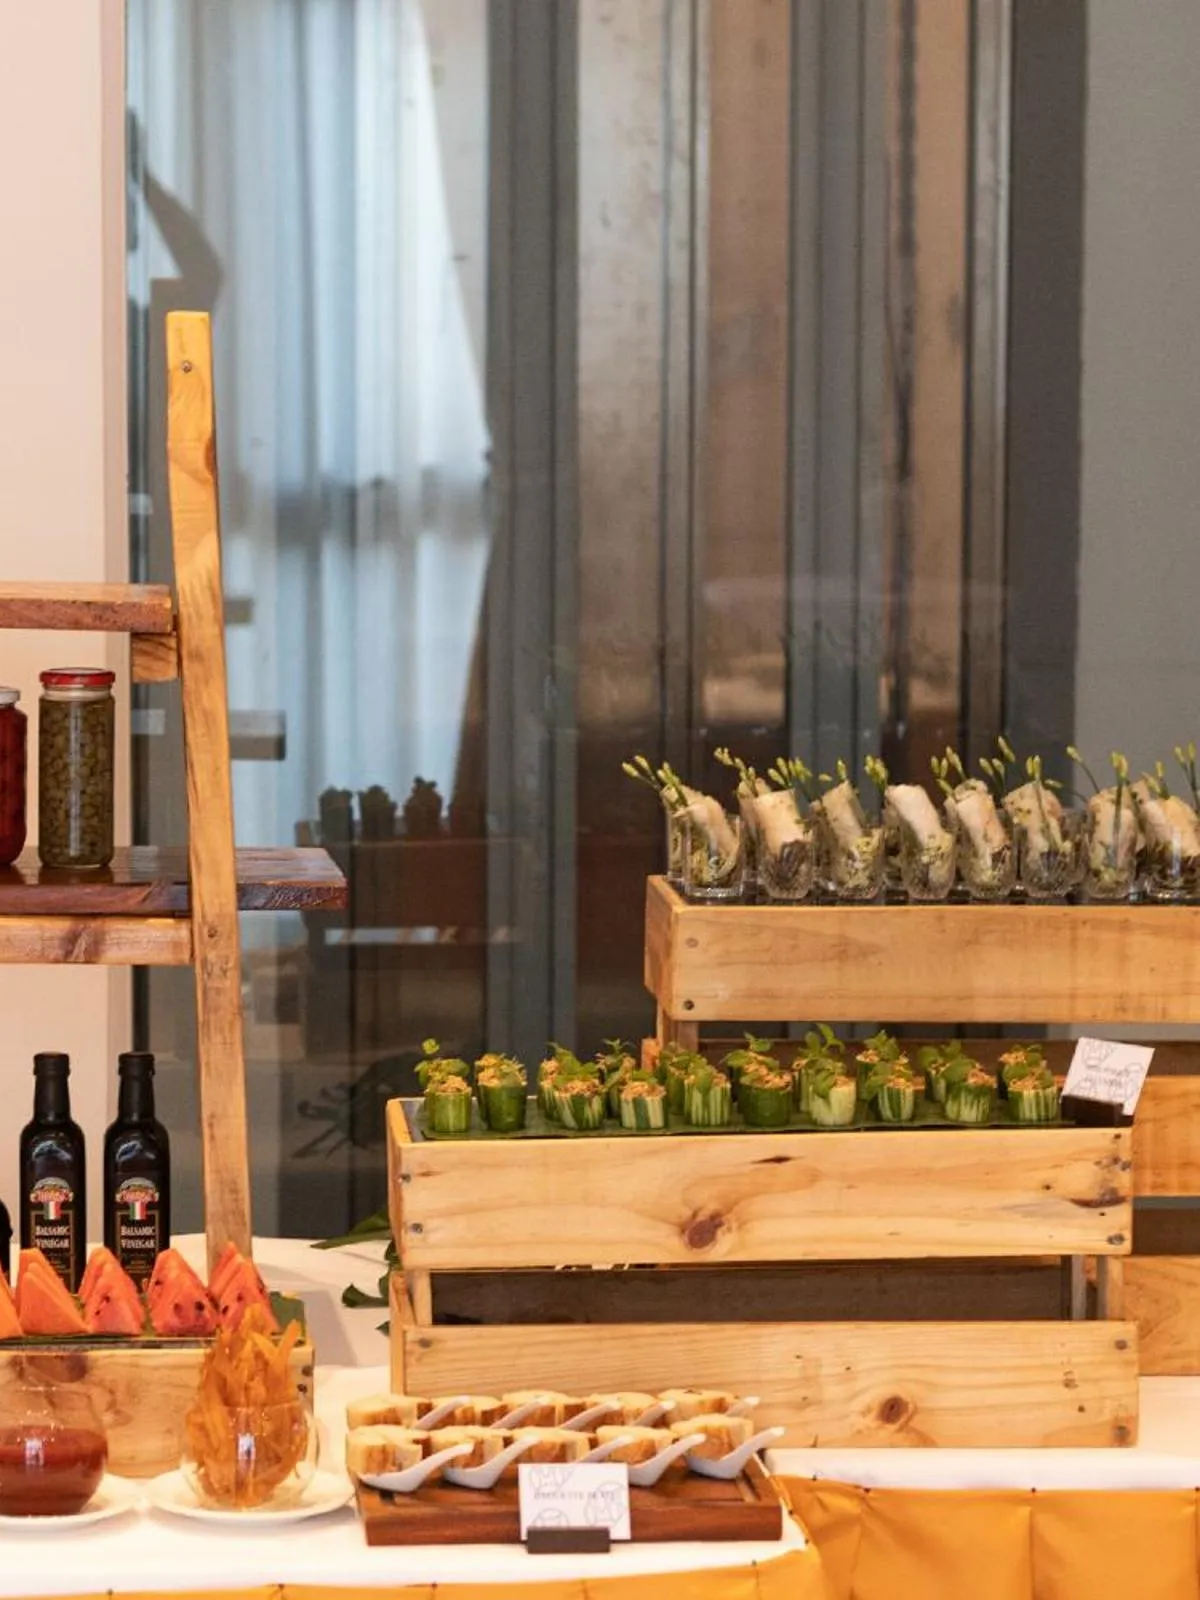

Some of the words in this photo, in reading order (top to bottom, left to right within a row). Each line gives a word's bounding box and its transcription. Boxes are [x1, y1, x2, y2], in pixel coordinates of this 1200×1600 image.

[35, 1225, 70, 1236] BALSAMIC
[121, 1225, 156, 1236] BALSAMIC
[35, 1238, 70, 1249] VINEGAR
[121, 1238, 156, 1249] VINEGAR
